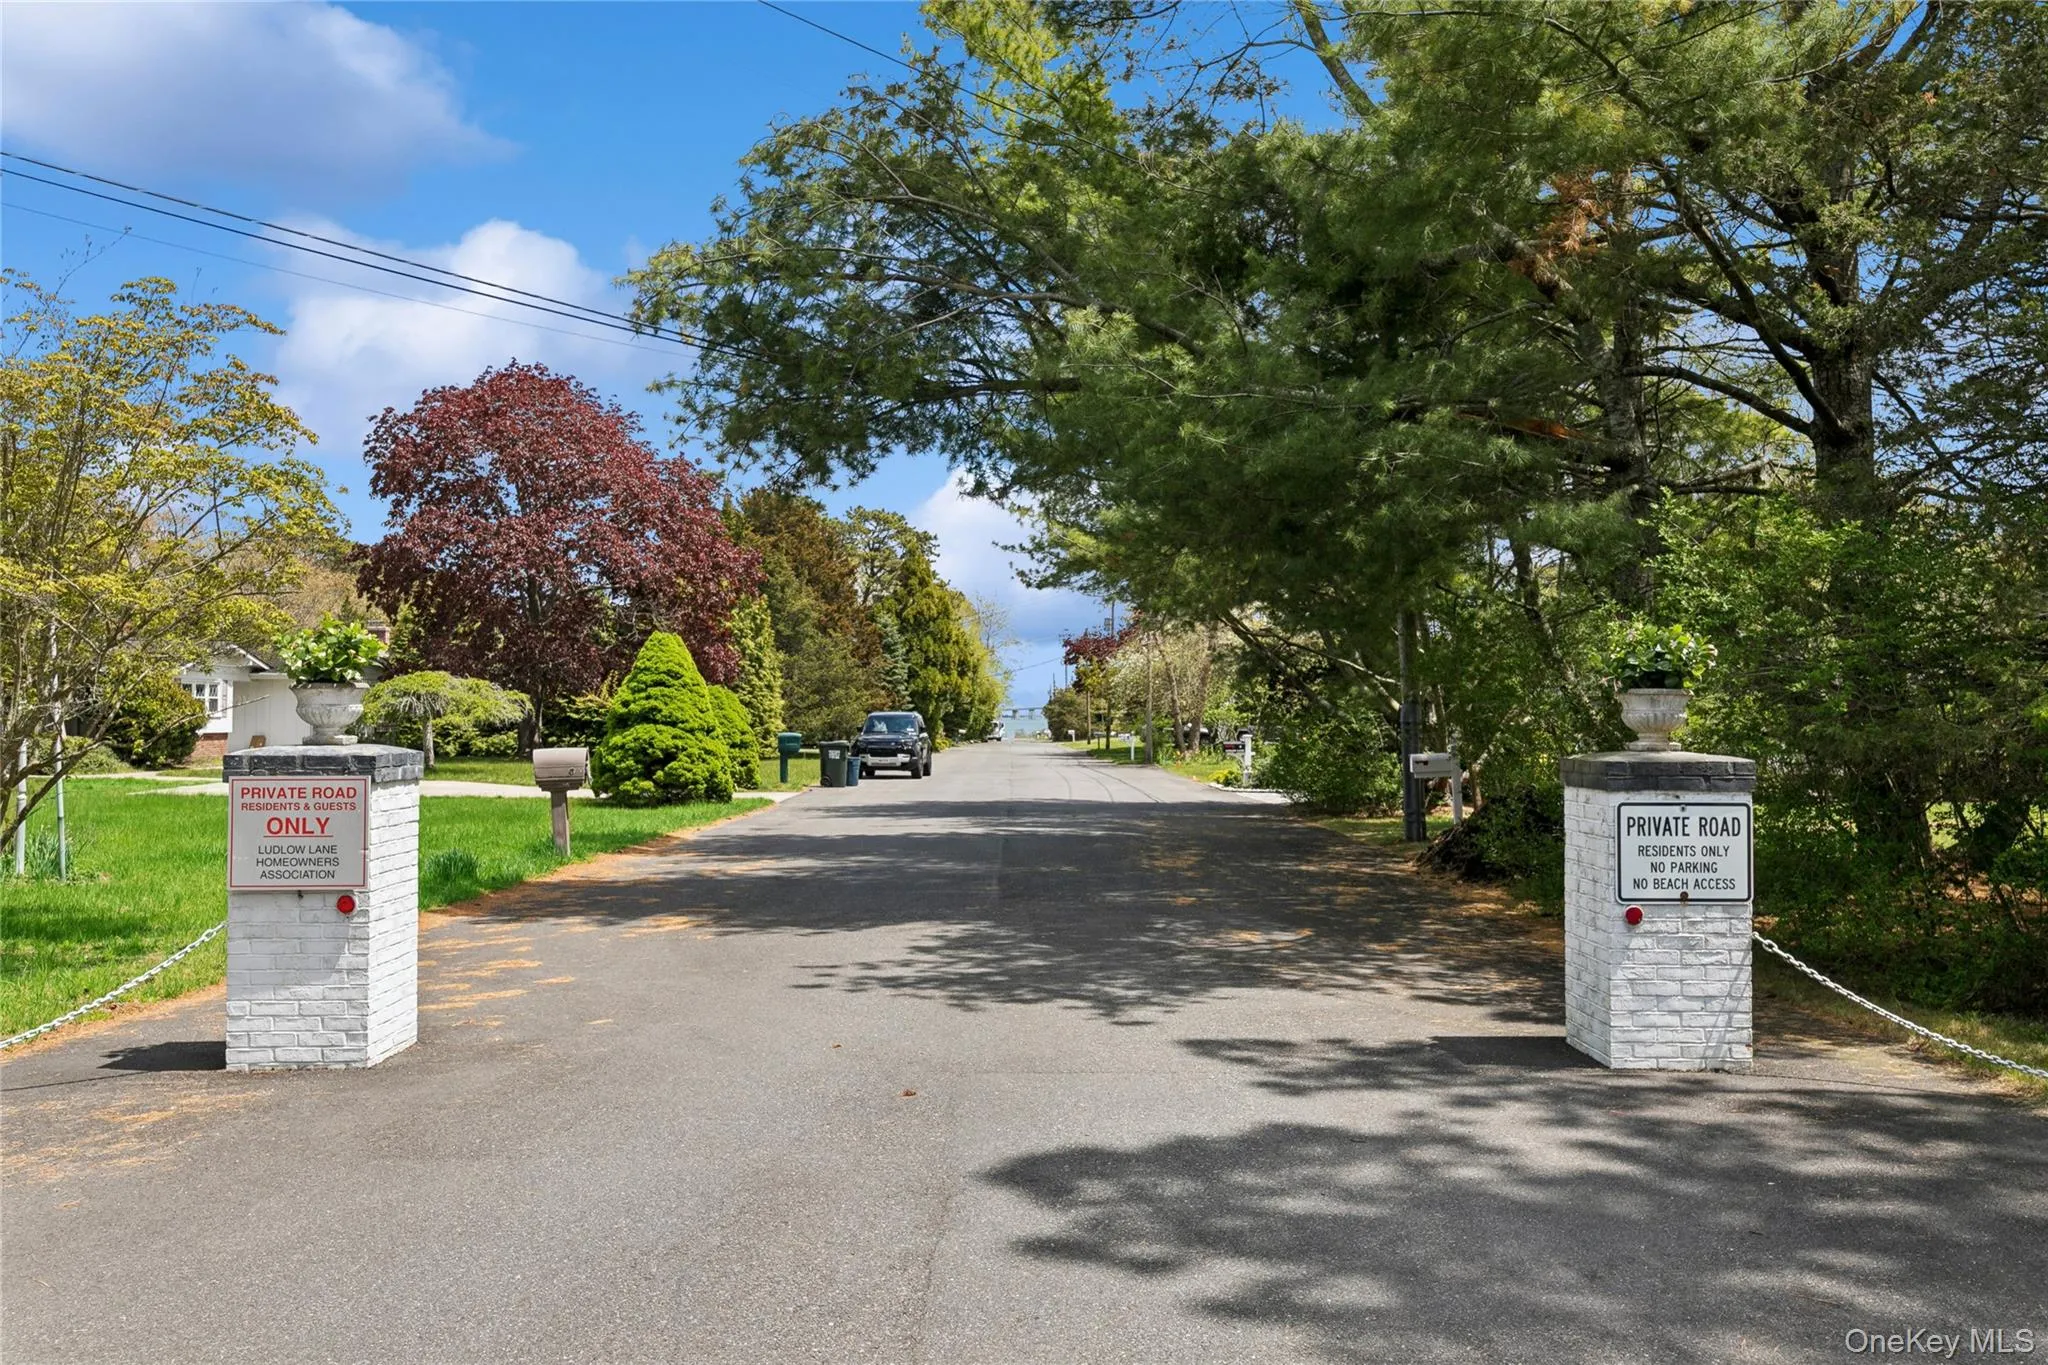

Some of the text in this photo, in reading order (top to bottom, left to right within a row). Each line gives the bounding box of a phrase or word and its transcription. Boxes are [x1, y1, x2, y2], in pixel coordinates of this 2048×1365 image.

[241, 787, 357, 799] PRIVATE ROAD
[241, 802, 356, 811] RESIDENTS & GUESTS
[266, 817, 330, 835] ONLY
[1627, 816, 1741, 837] PRIVATE ROAD
[258, 844, 338, 855] LUDLOW LANE
[1638, 845, 1730, 857] RESIDENTS ONLY
[256, 857, 340, 867] HOMEOWNERS
[1650, 862, 1718, 873] NO PARKING
[260, 870, 335, 879] ASSOCIATION
[1633, 878, 1736, 890] NO BEACH ACCESS
